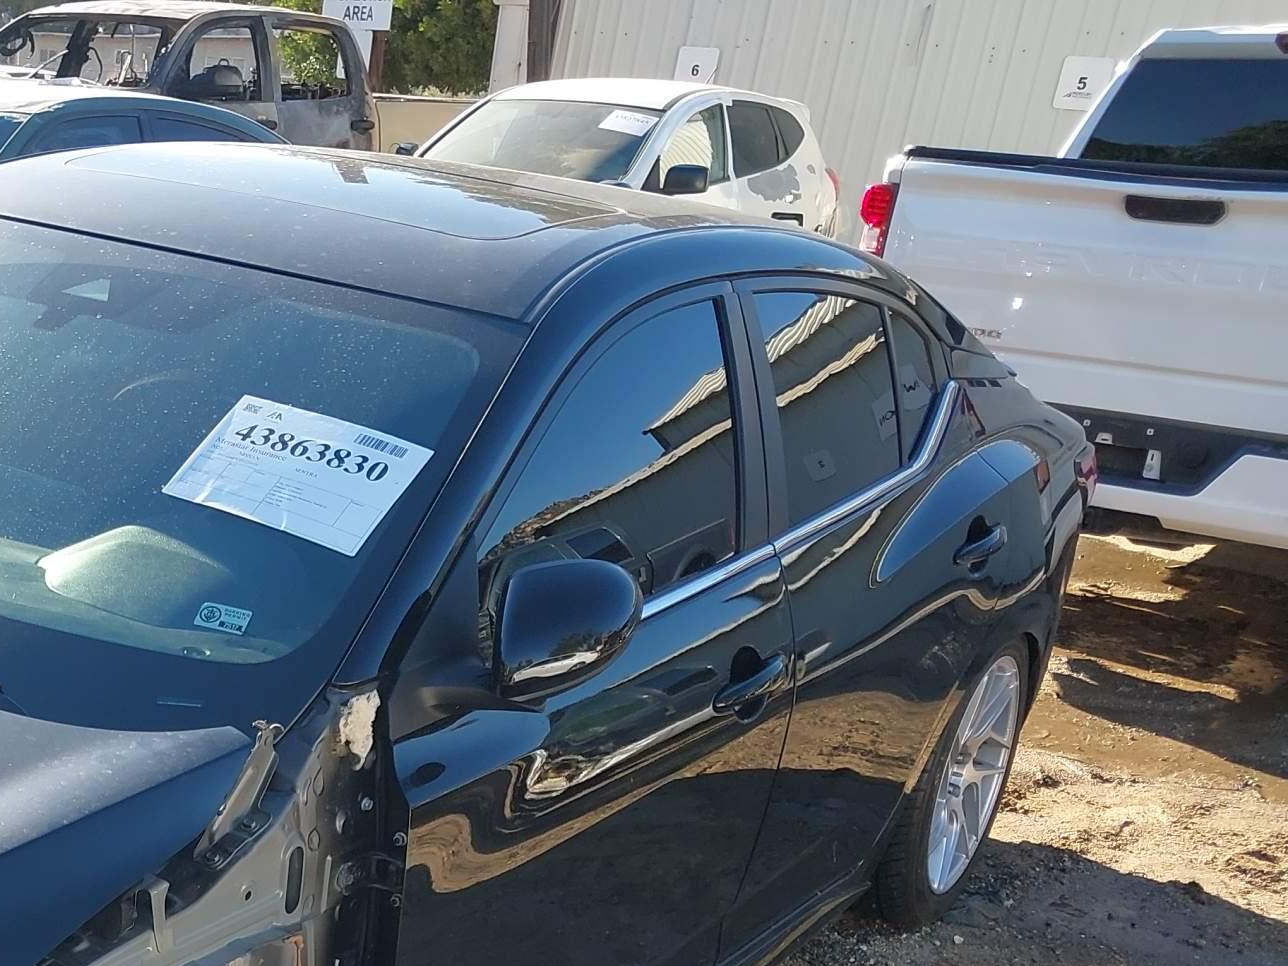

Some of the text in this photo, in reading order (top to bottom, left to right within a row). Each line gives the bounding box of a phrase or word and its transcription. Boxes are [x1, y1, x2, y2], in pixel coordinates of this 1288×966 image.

[343, 6, 373, 21] AREA
[691, 64, 700, 77] 6
[1076, 76, 1088, 90] 5
[234, 424, 389, 482] 43863830
[251, 446, 288, 461] Insurance
